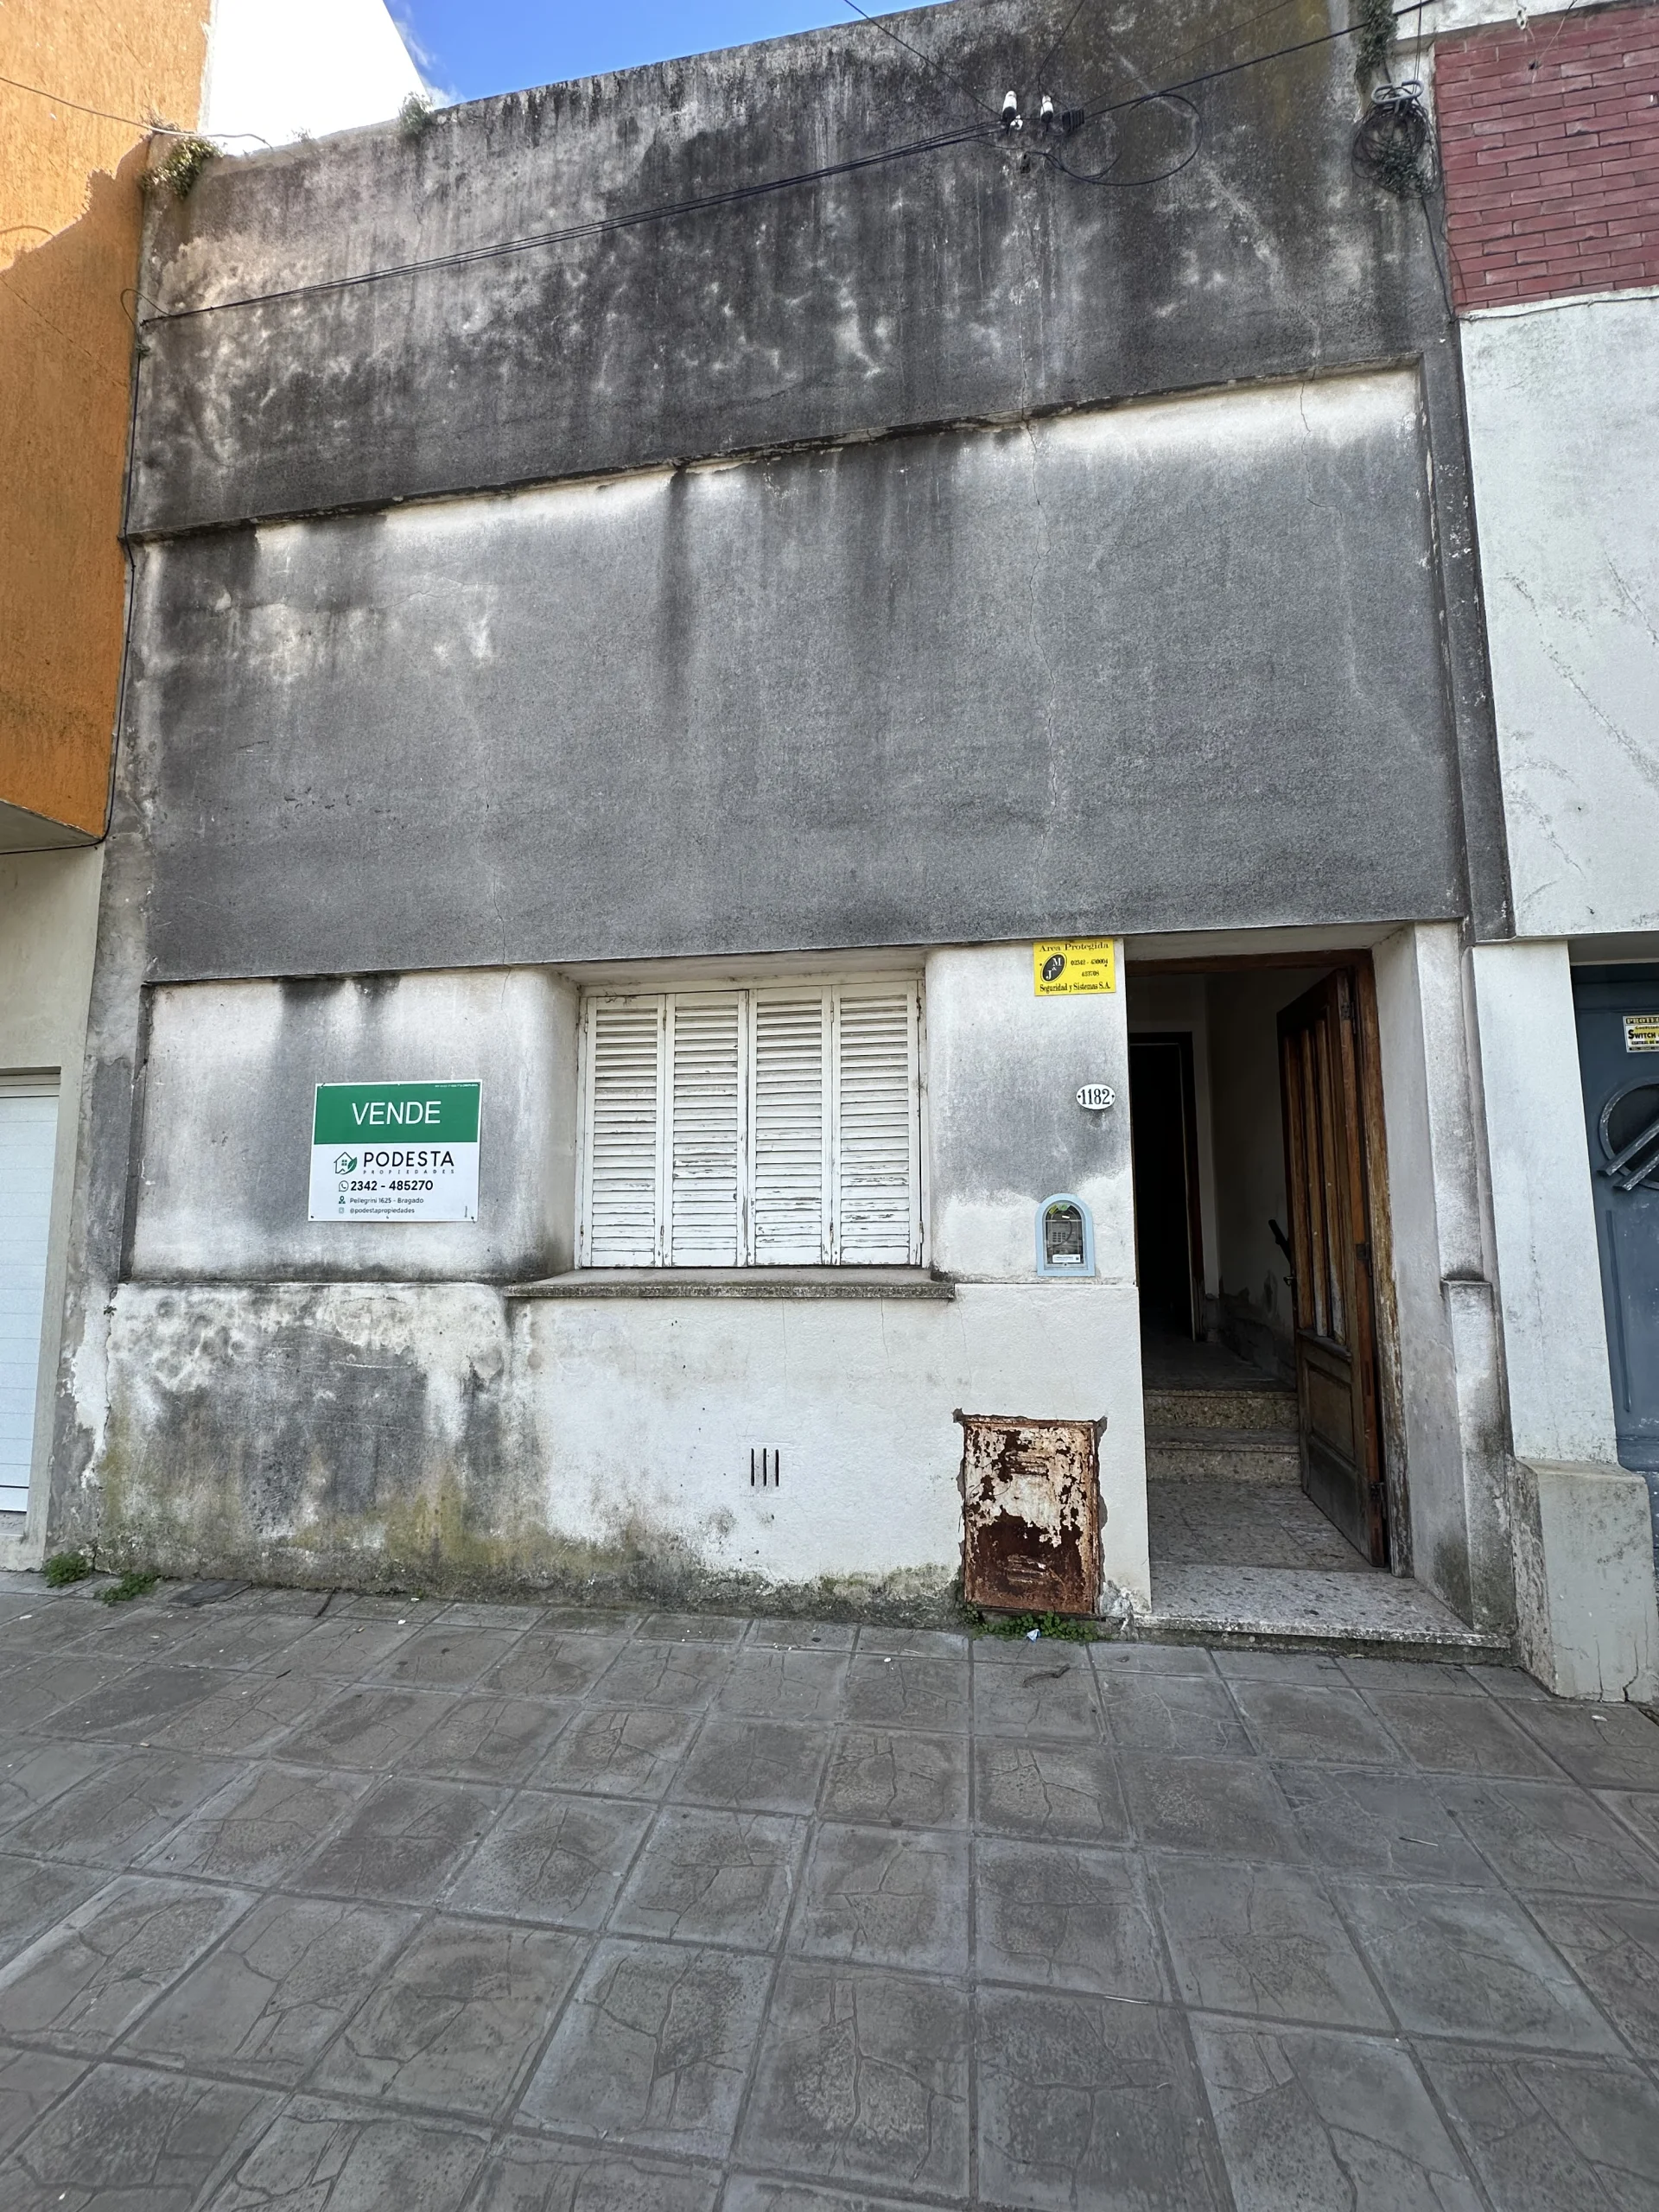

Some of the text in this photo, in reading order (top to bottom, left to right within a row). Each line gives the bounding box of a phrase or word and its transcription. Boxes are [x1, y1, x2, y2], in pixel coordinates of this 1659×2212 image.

[1065, 942, 1109, 951] Protegida
[1052, 957, 1062, 966] M
[1046, 970, 1052, 980] J
[1039, 983, 1068, 994] Seguridad
[1081, 1089, 1110, 1104] 1182
[352, 1101, 442, 1125] VENDE
[363, 1151, 454, 1167] PODESTA
[350, 1180, 378, 1192] 2342
[388, 1179, 434, 1191] 485270
